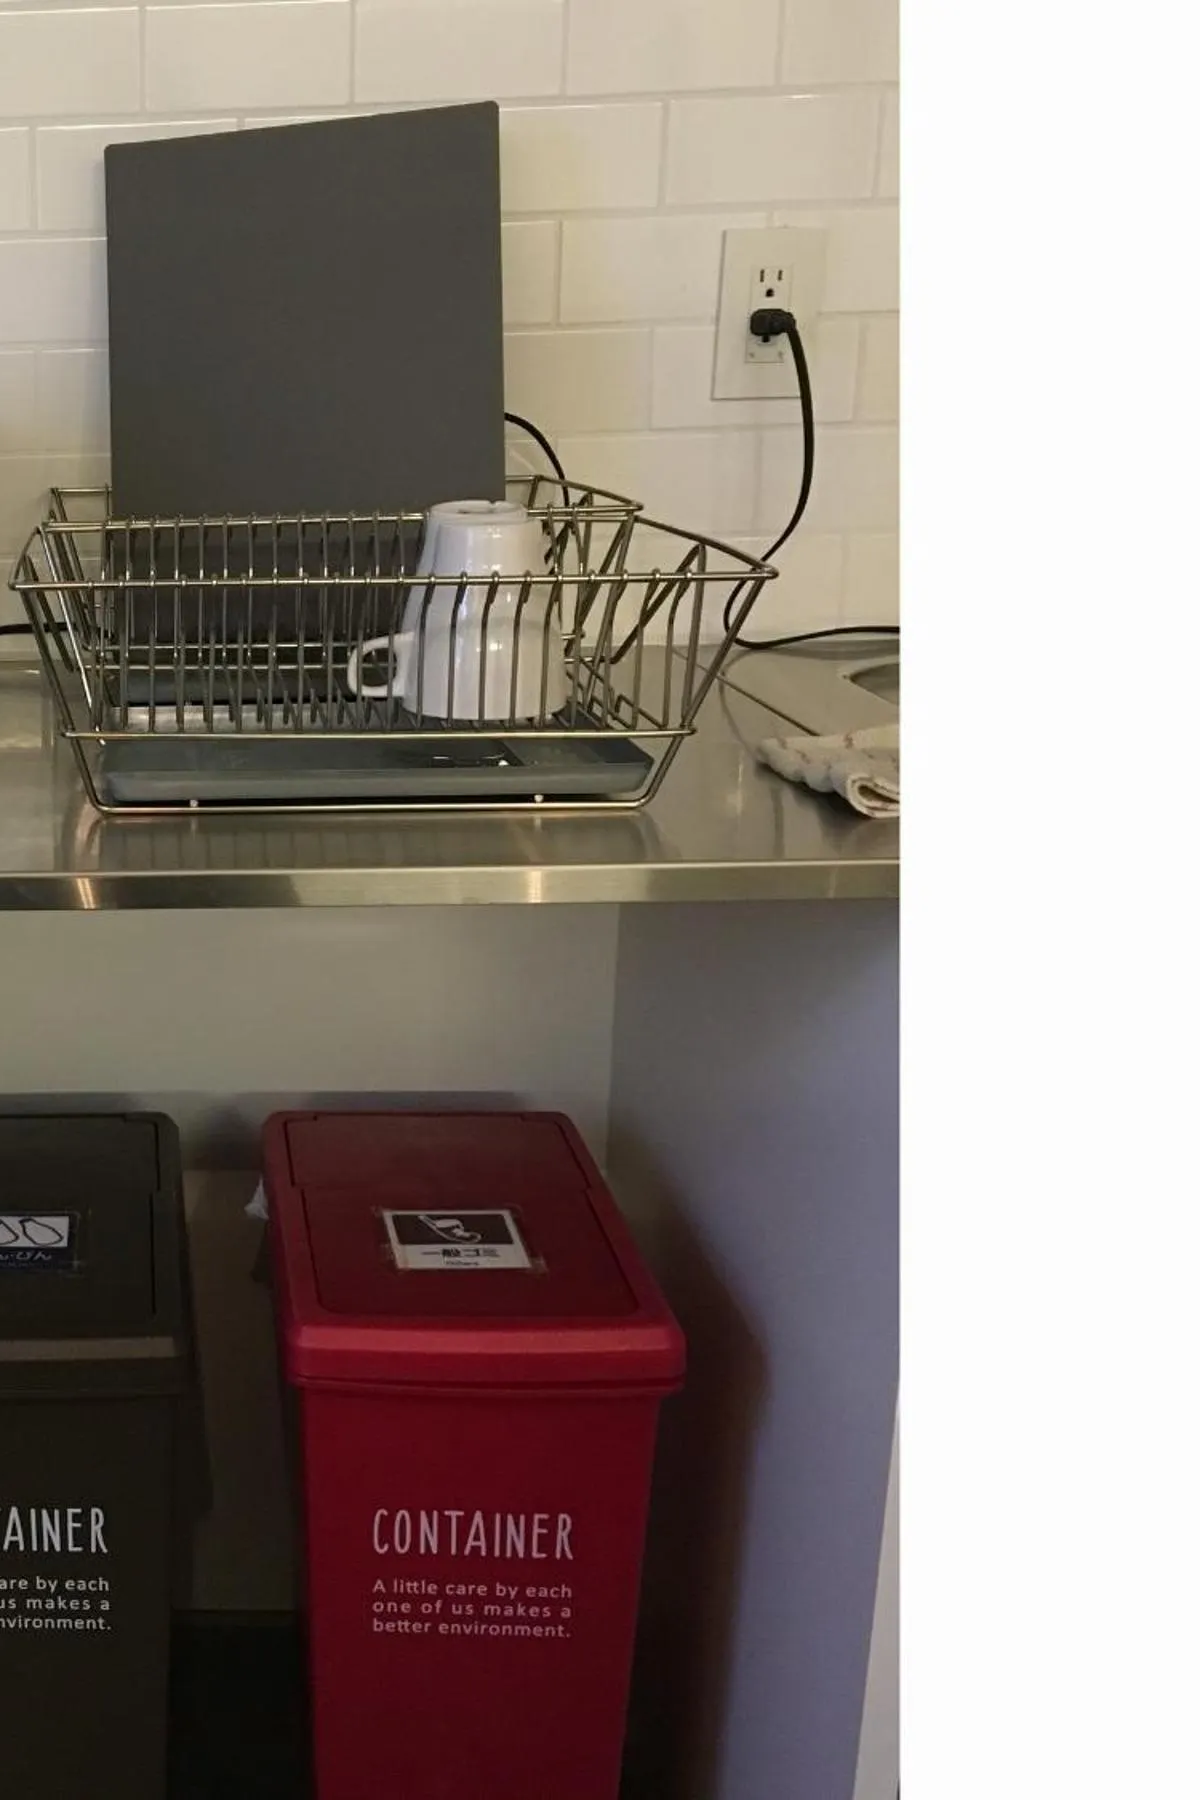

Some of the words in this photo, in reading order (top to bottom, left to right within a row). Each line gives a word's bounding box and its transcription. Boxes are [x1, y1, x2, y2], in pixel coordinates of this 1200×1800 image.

[373, 1508, 573, 1560] CONTAINER
[36, 1576, 58, 1593] by
[65, 1577, 109, 1591] each
[372, 1579, 386, 1594] A
[393, 1579, 438, 1594] little
[446, 1583, 488, 1596] care
[495, 1582, 518, 1600] by
[526, 1584, 572, 1598] each
[26, 1596, 91, 1610] makes
[100, 1599, 110, 1610] a
[372, 1601, 411, 1613] one
[421, 1600, 443, 1614] of
[452, 1603, 474, 1615] us
[484, 1603, 551, 1617] makes
[561, 1606, 571, 1618] a
[373, 1618, 431, 1633] better
[438, 1621, 571, 1637] environment.
